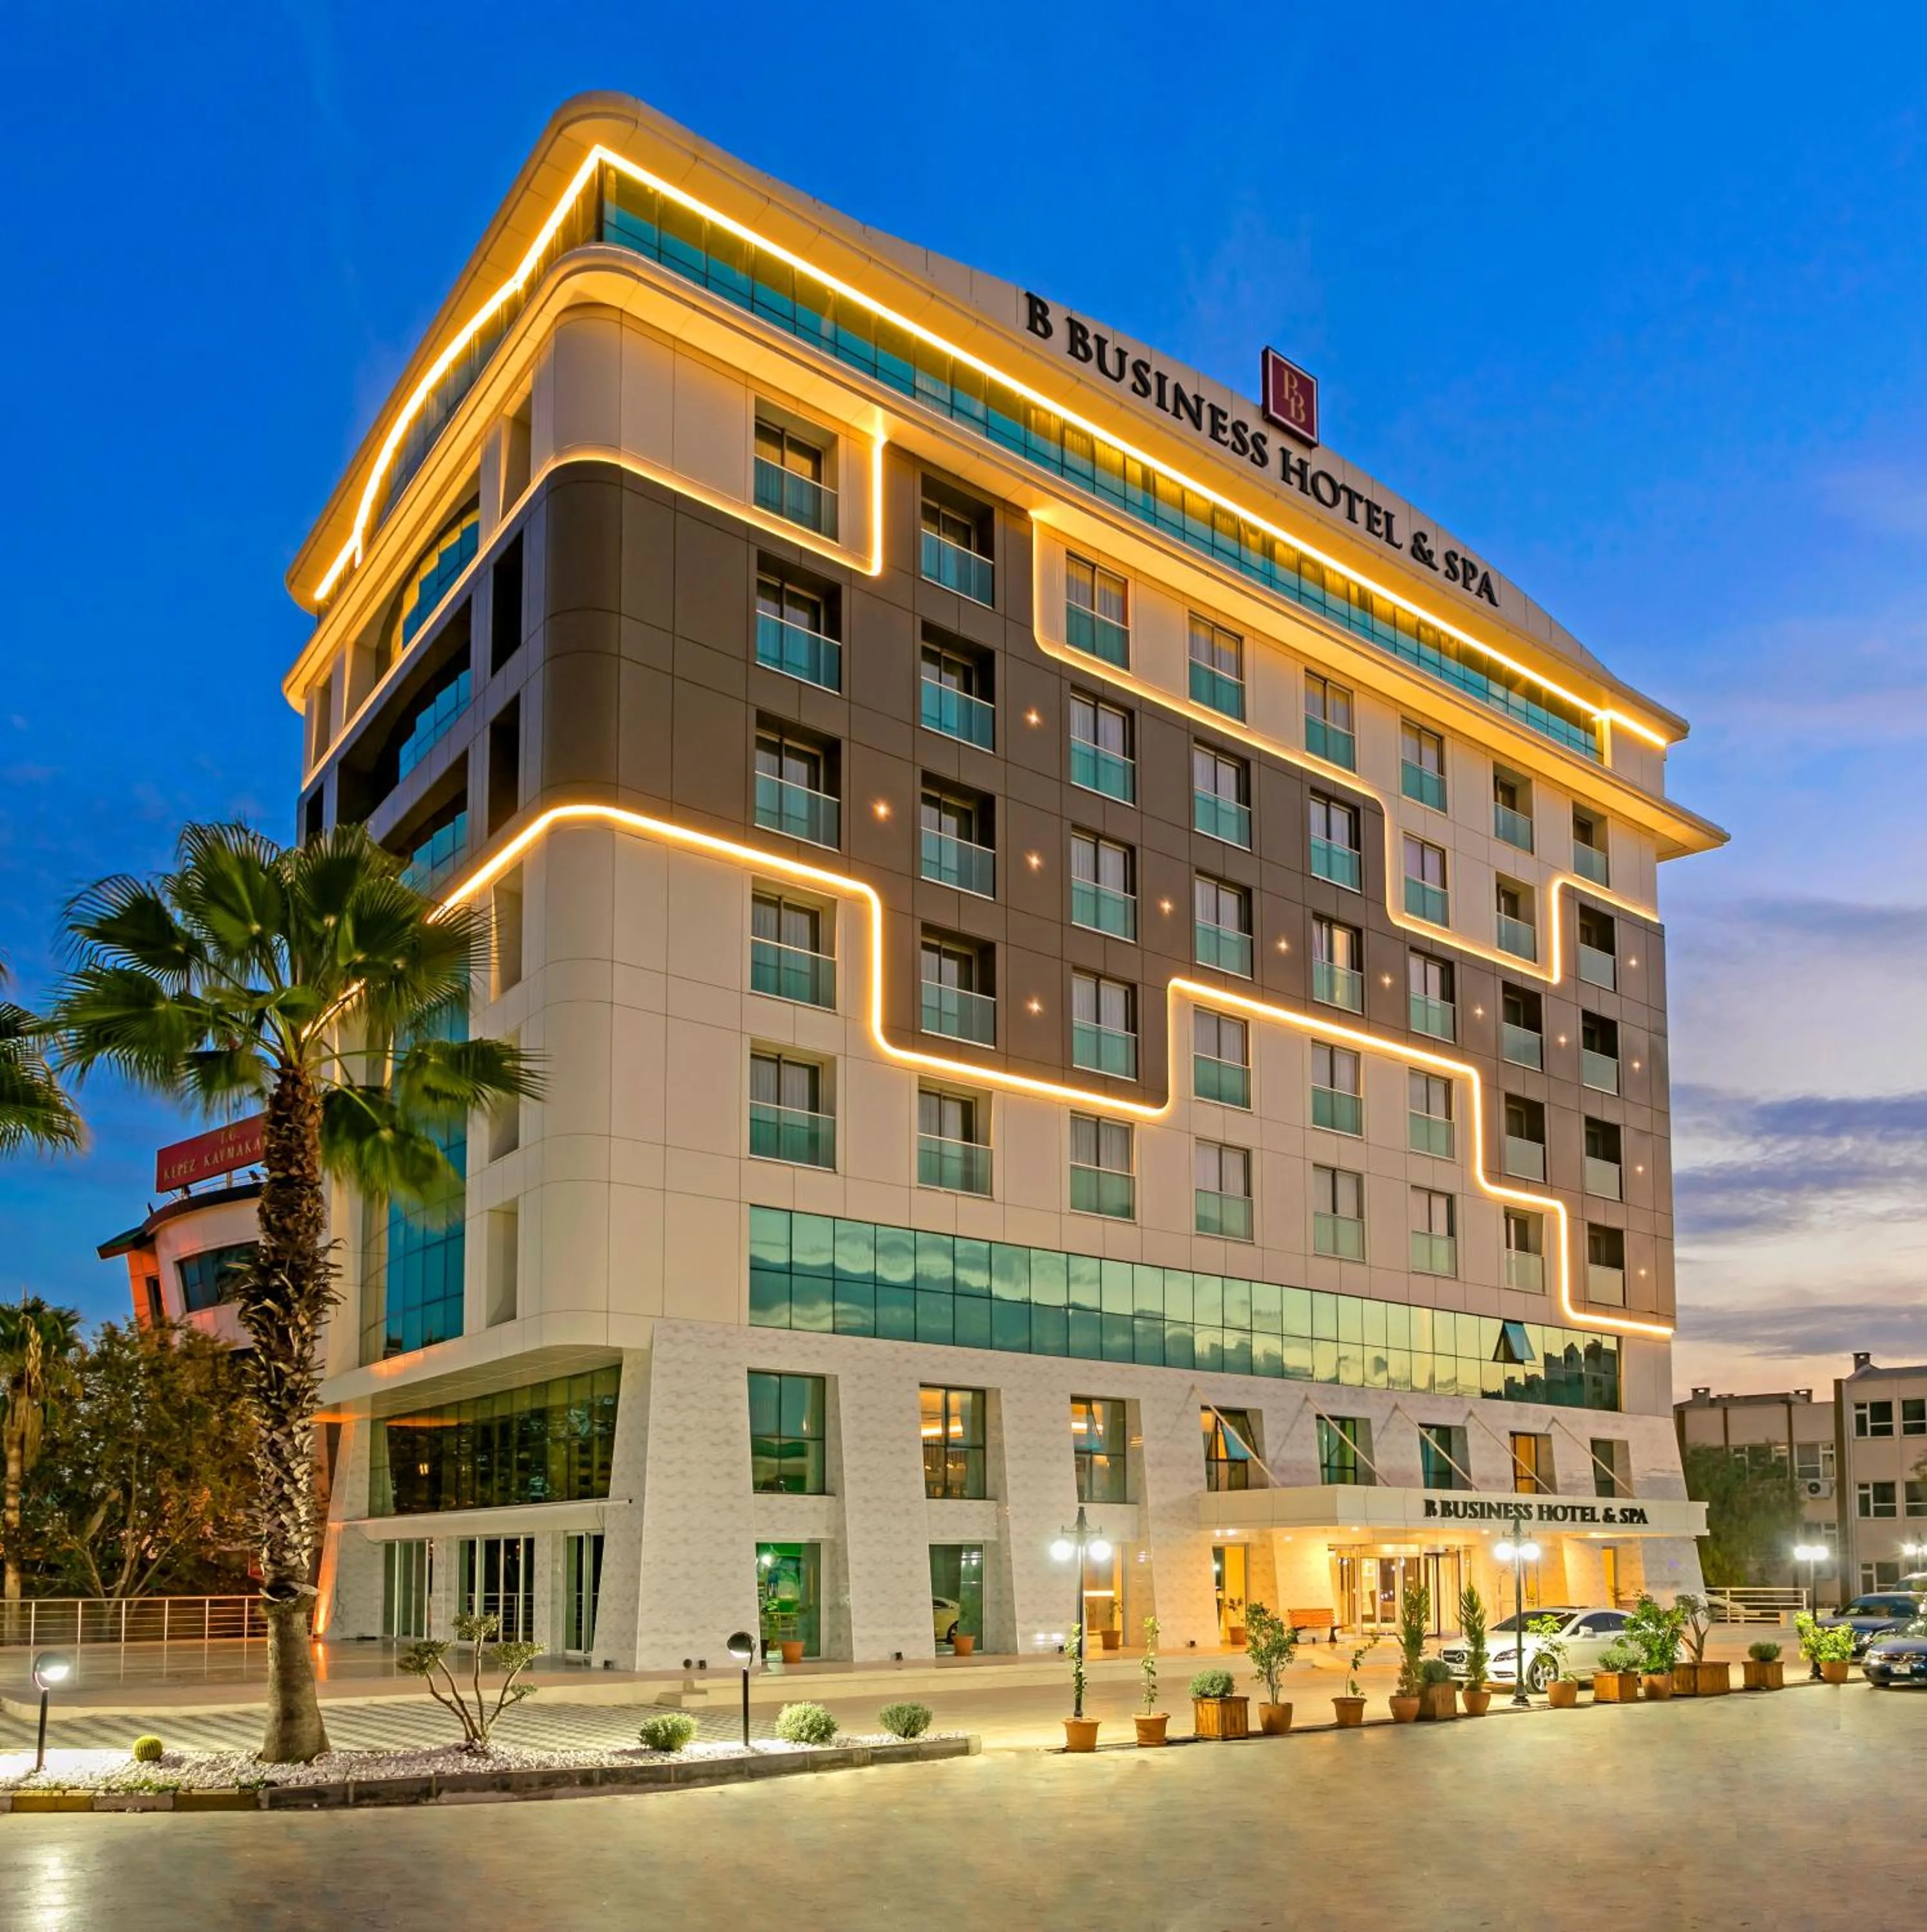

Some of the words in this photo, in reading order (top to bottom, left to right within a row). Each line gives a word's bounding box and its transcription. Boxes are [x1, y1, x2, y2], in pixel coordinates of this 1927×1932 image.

[1025, 291, 1053, 339] B
[1066, 316, 1269, 469] BUSINESS
[1279, 447, 1403, 549] HOTEL
[1411, 531, 1439, 571] &
[1445, 550, 1499, 607] SPA
[164, 1159, 196, 1181] KEPEZ
[204, 1137, 261, 1168] KAYMAKA
[1424, 1499, 1438, 1517] B
[1439, 1500, 1533, 1520] BUSINESS
[1537, 1504, 1600, 1522] HOTEL
[1602, 1507, 1617, 1523] &
[1619, 1508, 1649, 1524] SPA
